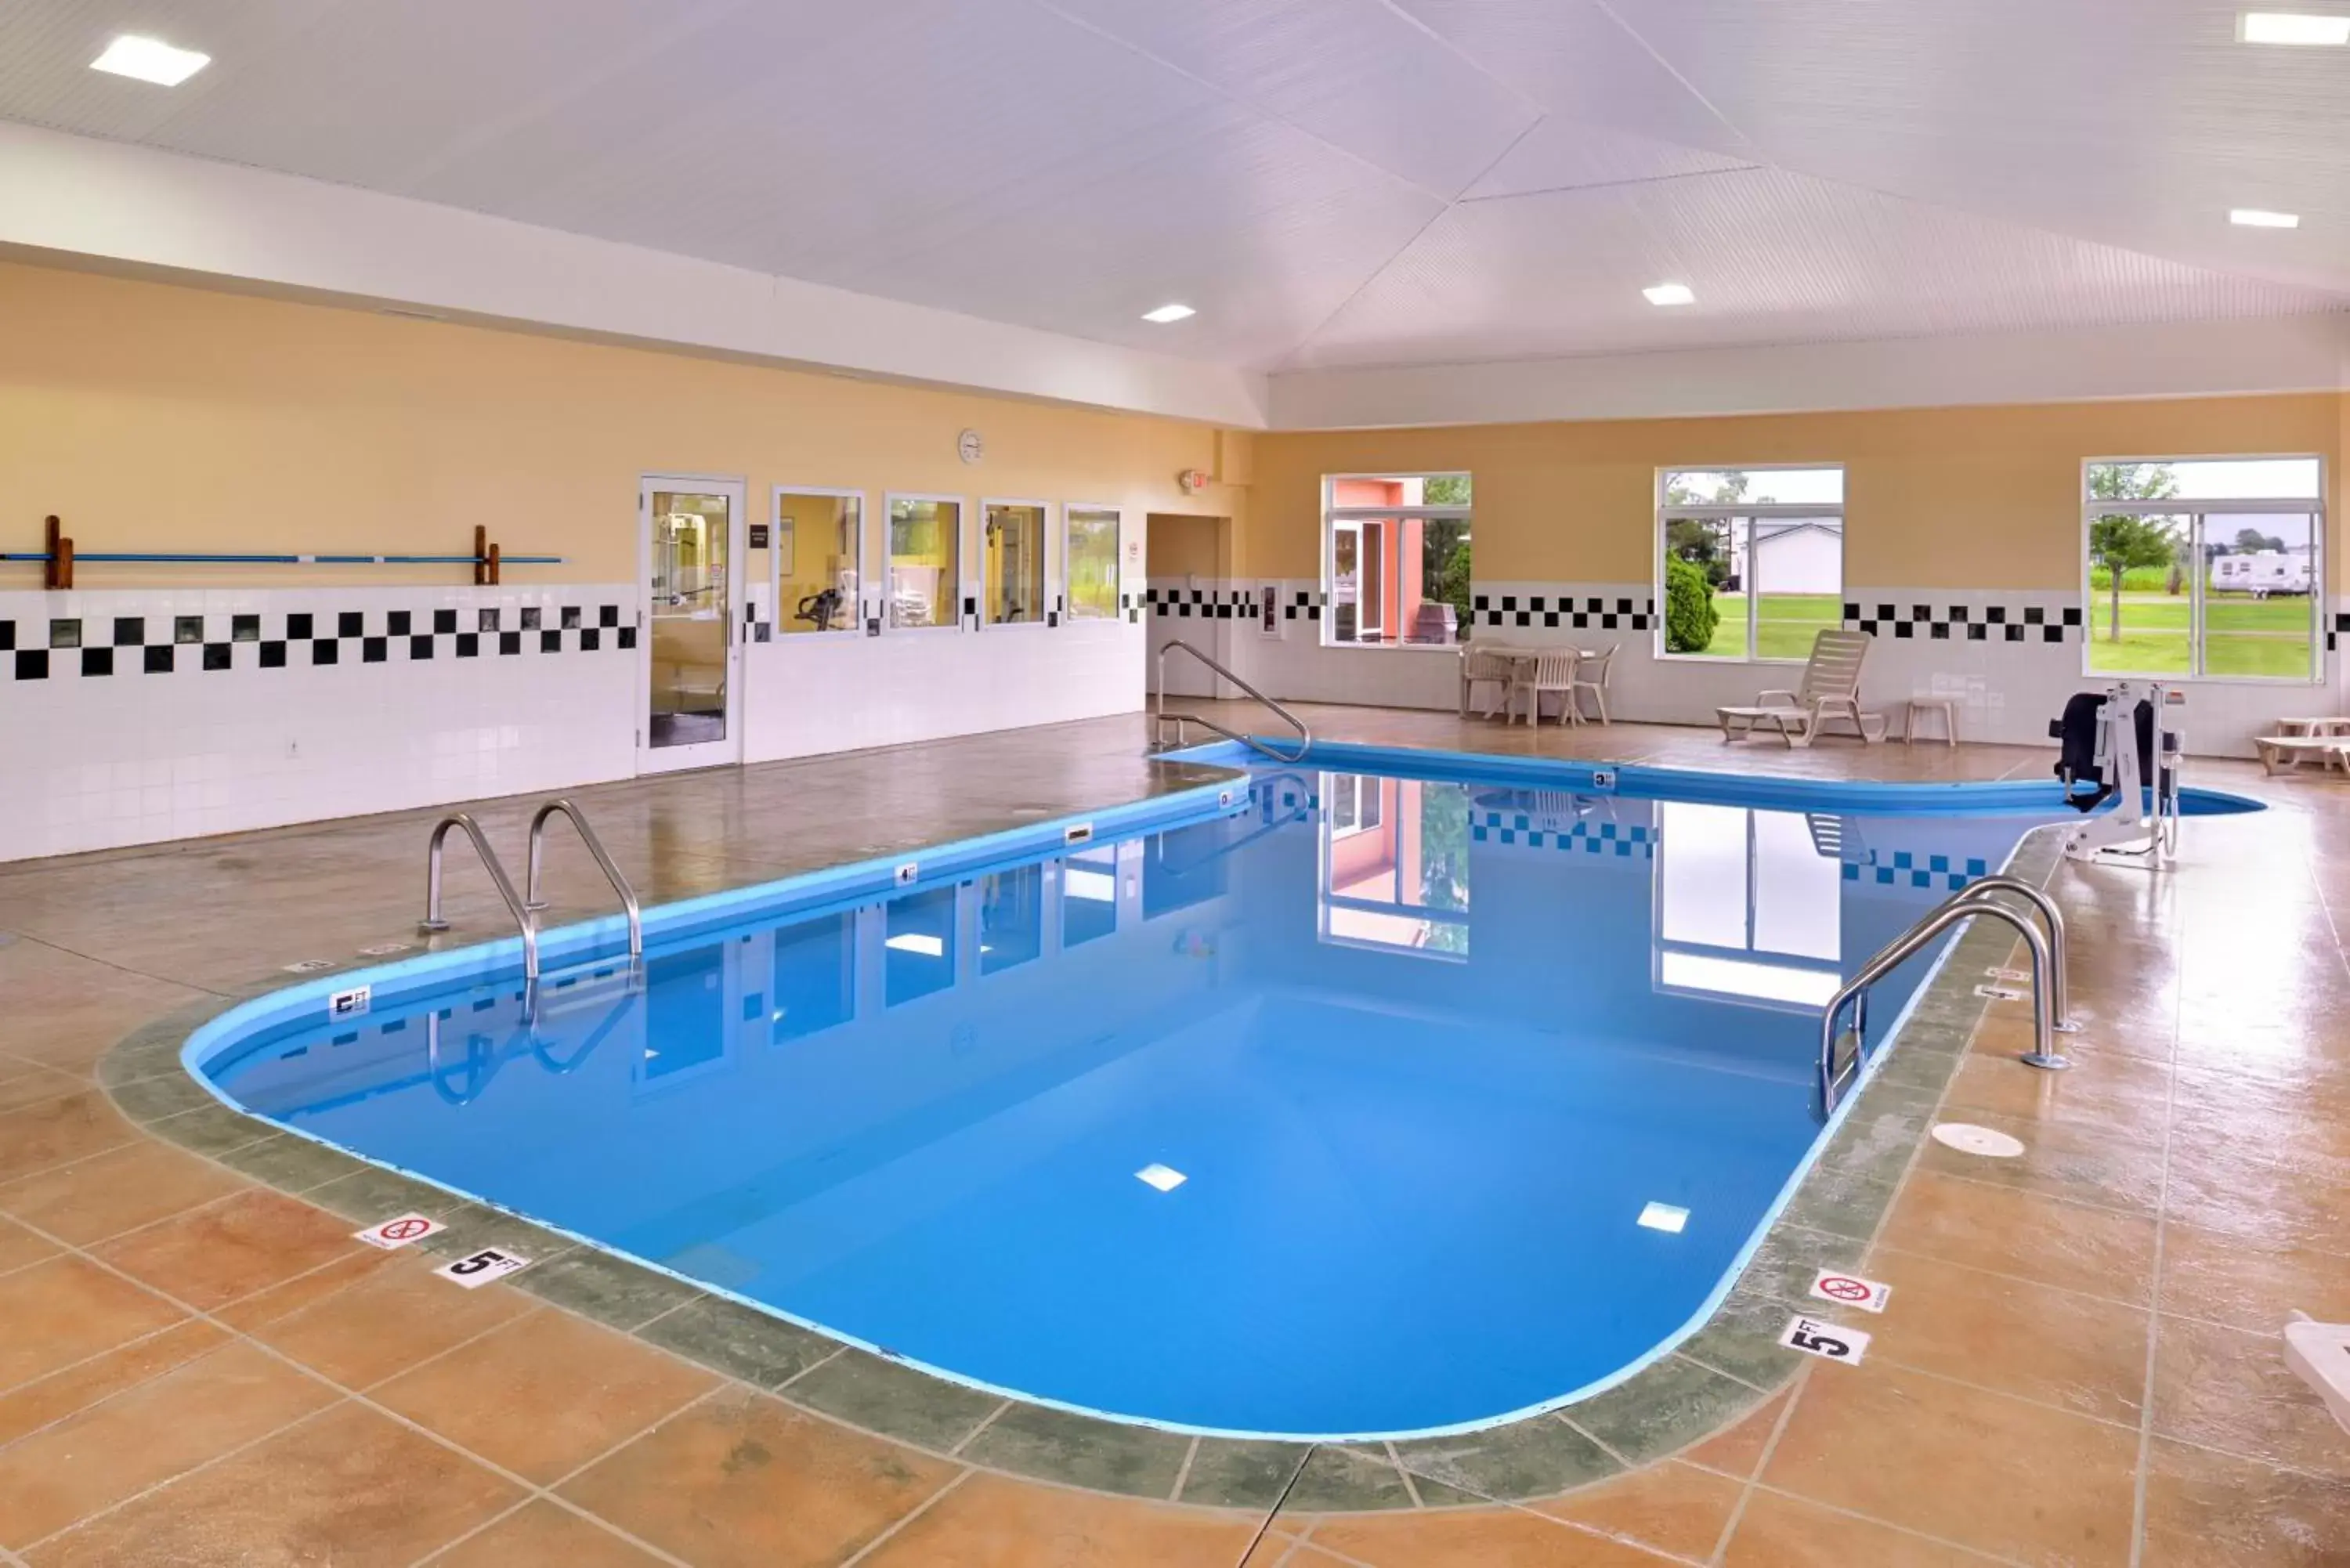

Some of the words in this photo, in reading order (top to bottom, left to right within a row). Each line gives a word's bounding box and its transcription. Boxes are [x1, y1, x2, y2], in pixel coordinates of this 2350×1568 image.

[450, 1251, 504, 1275] 5
[496, 1259, 522, 1270] FT
[1799, 1319, 1820, 1334] FT
[1791, 1331, 1849, 1356] 5
